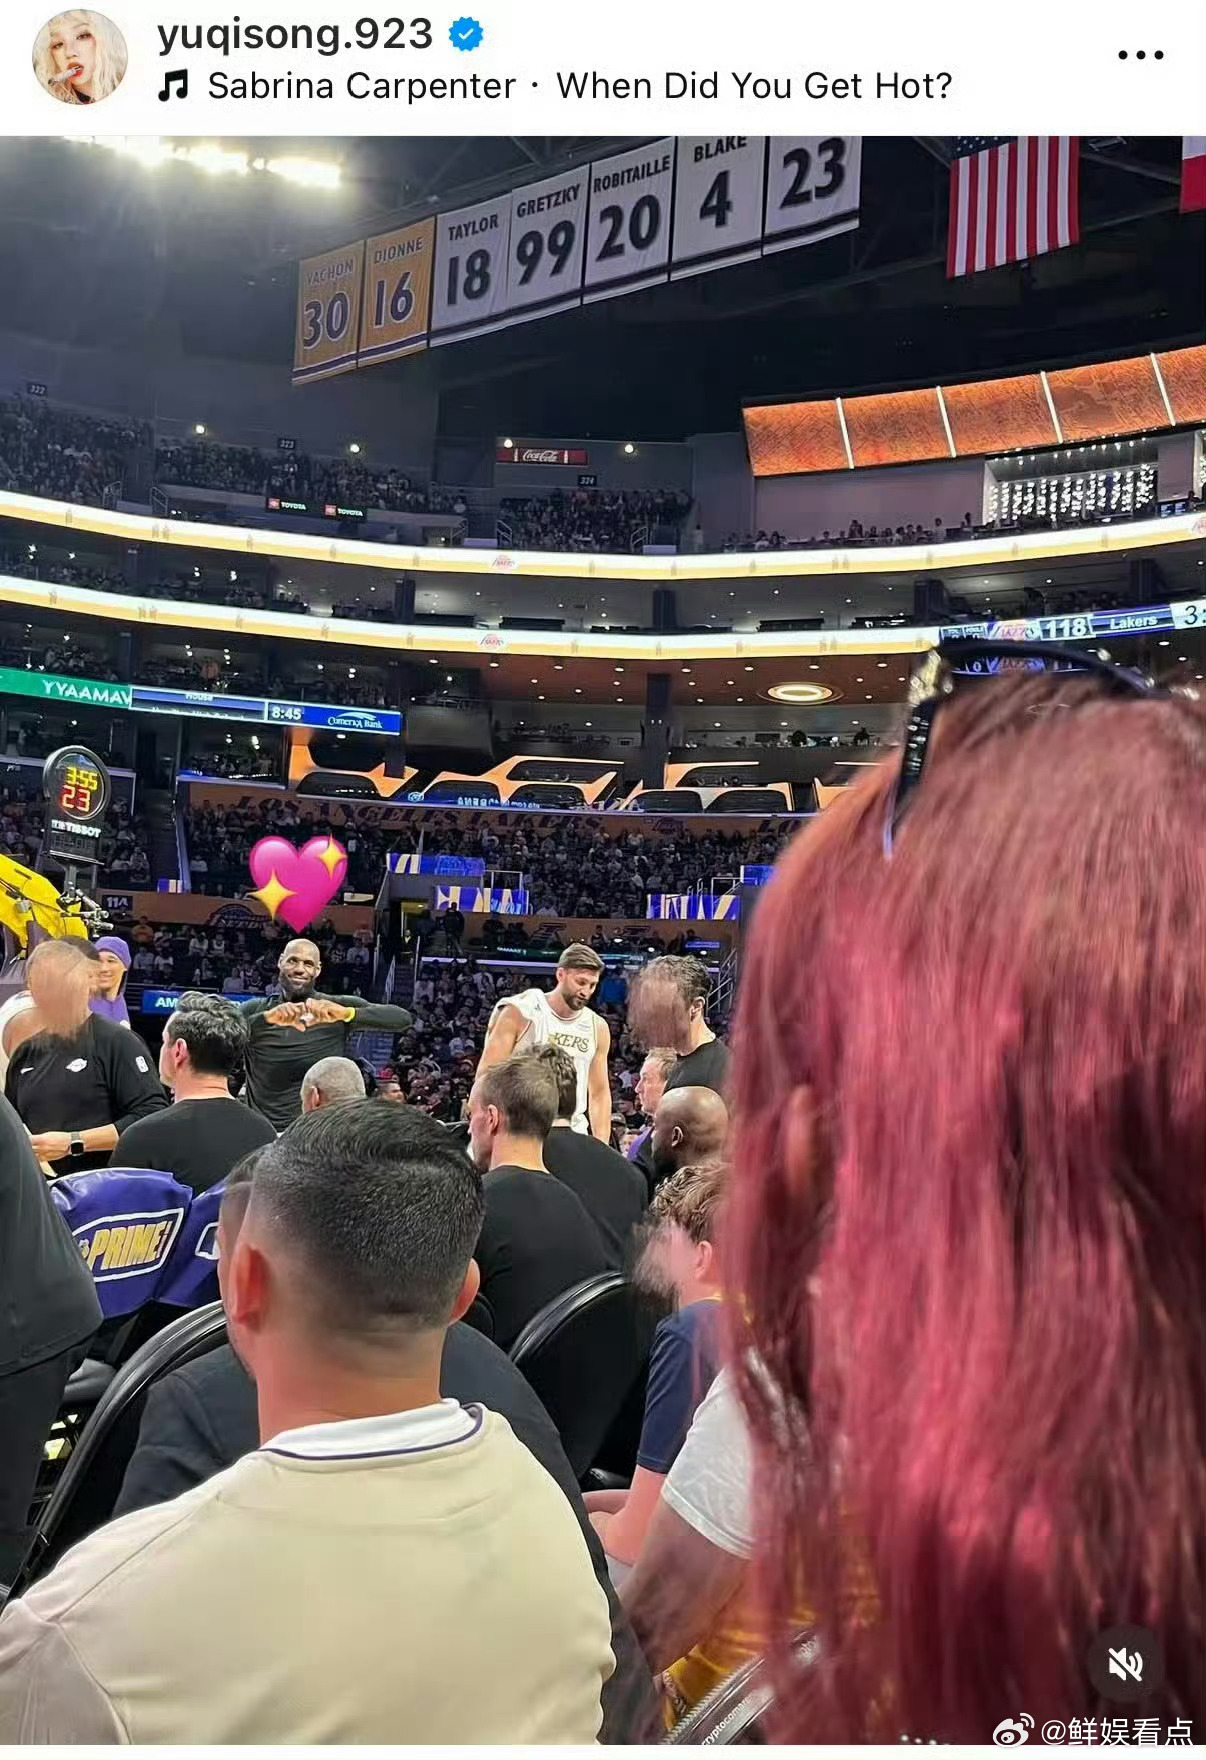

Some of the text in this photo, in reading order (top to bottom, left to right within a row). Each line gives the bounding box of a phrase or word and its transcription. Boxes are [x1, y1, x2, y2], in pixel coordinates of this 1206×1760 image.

[694, 136, 747, 162] BLAKE
[593, 155, 670, 193] ROBITAILLE
[779, 137, 846, 210] 23
[516, 184, 580, 218] GRETZKY
[699, 170, 733, 228] 4
[448, 213, 498, 241] TAYLOR
[595, 194, 661, 263] 20
[374, 237, 423, 264] DIONNE
[516, 219, 576, 286] 99
[307, 260, 353, 284] VACHON
[447, 248, 490, 306] 18
[374, 271, 415, 328] 16
[303, 291, 350, 350] 30
[281, 502, 307, 510] TOYOTA
[337, 508, 364, 517] TOYOTA
[1045, 617, 1088, 638] 118
[1110, 616, 1158, 630] Lakers
[271, 706, 302, 721] 8:45
[61, 784, 91, 812] 23
[549, 1032, 590, 1053] KERS
